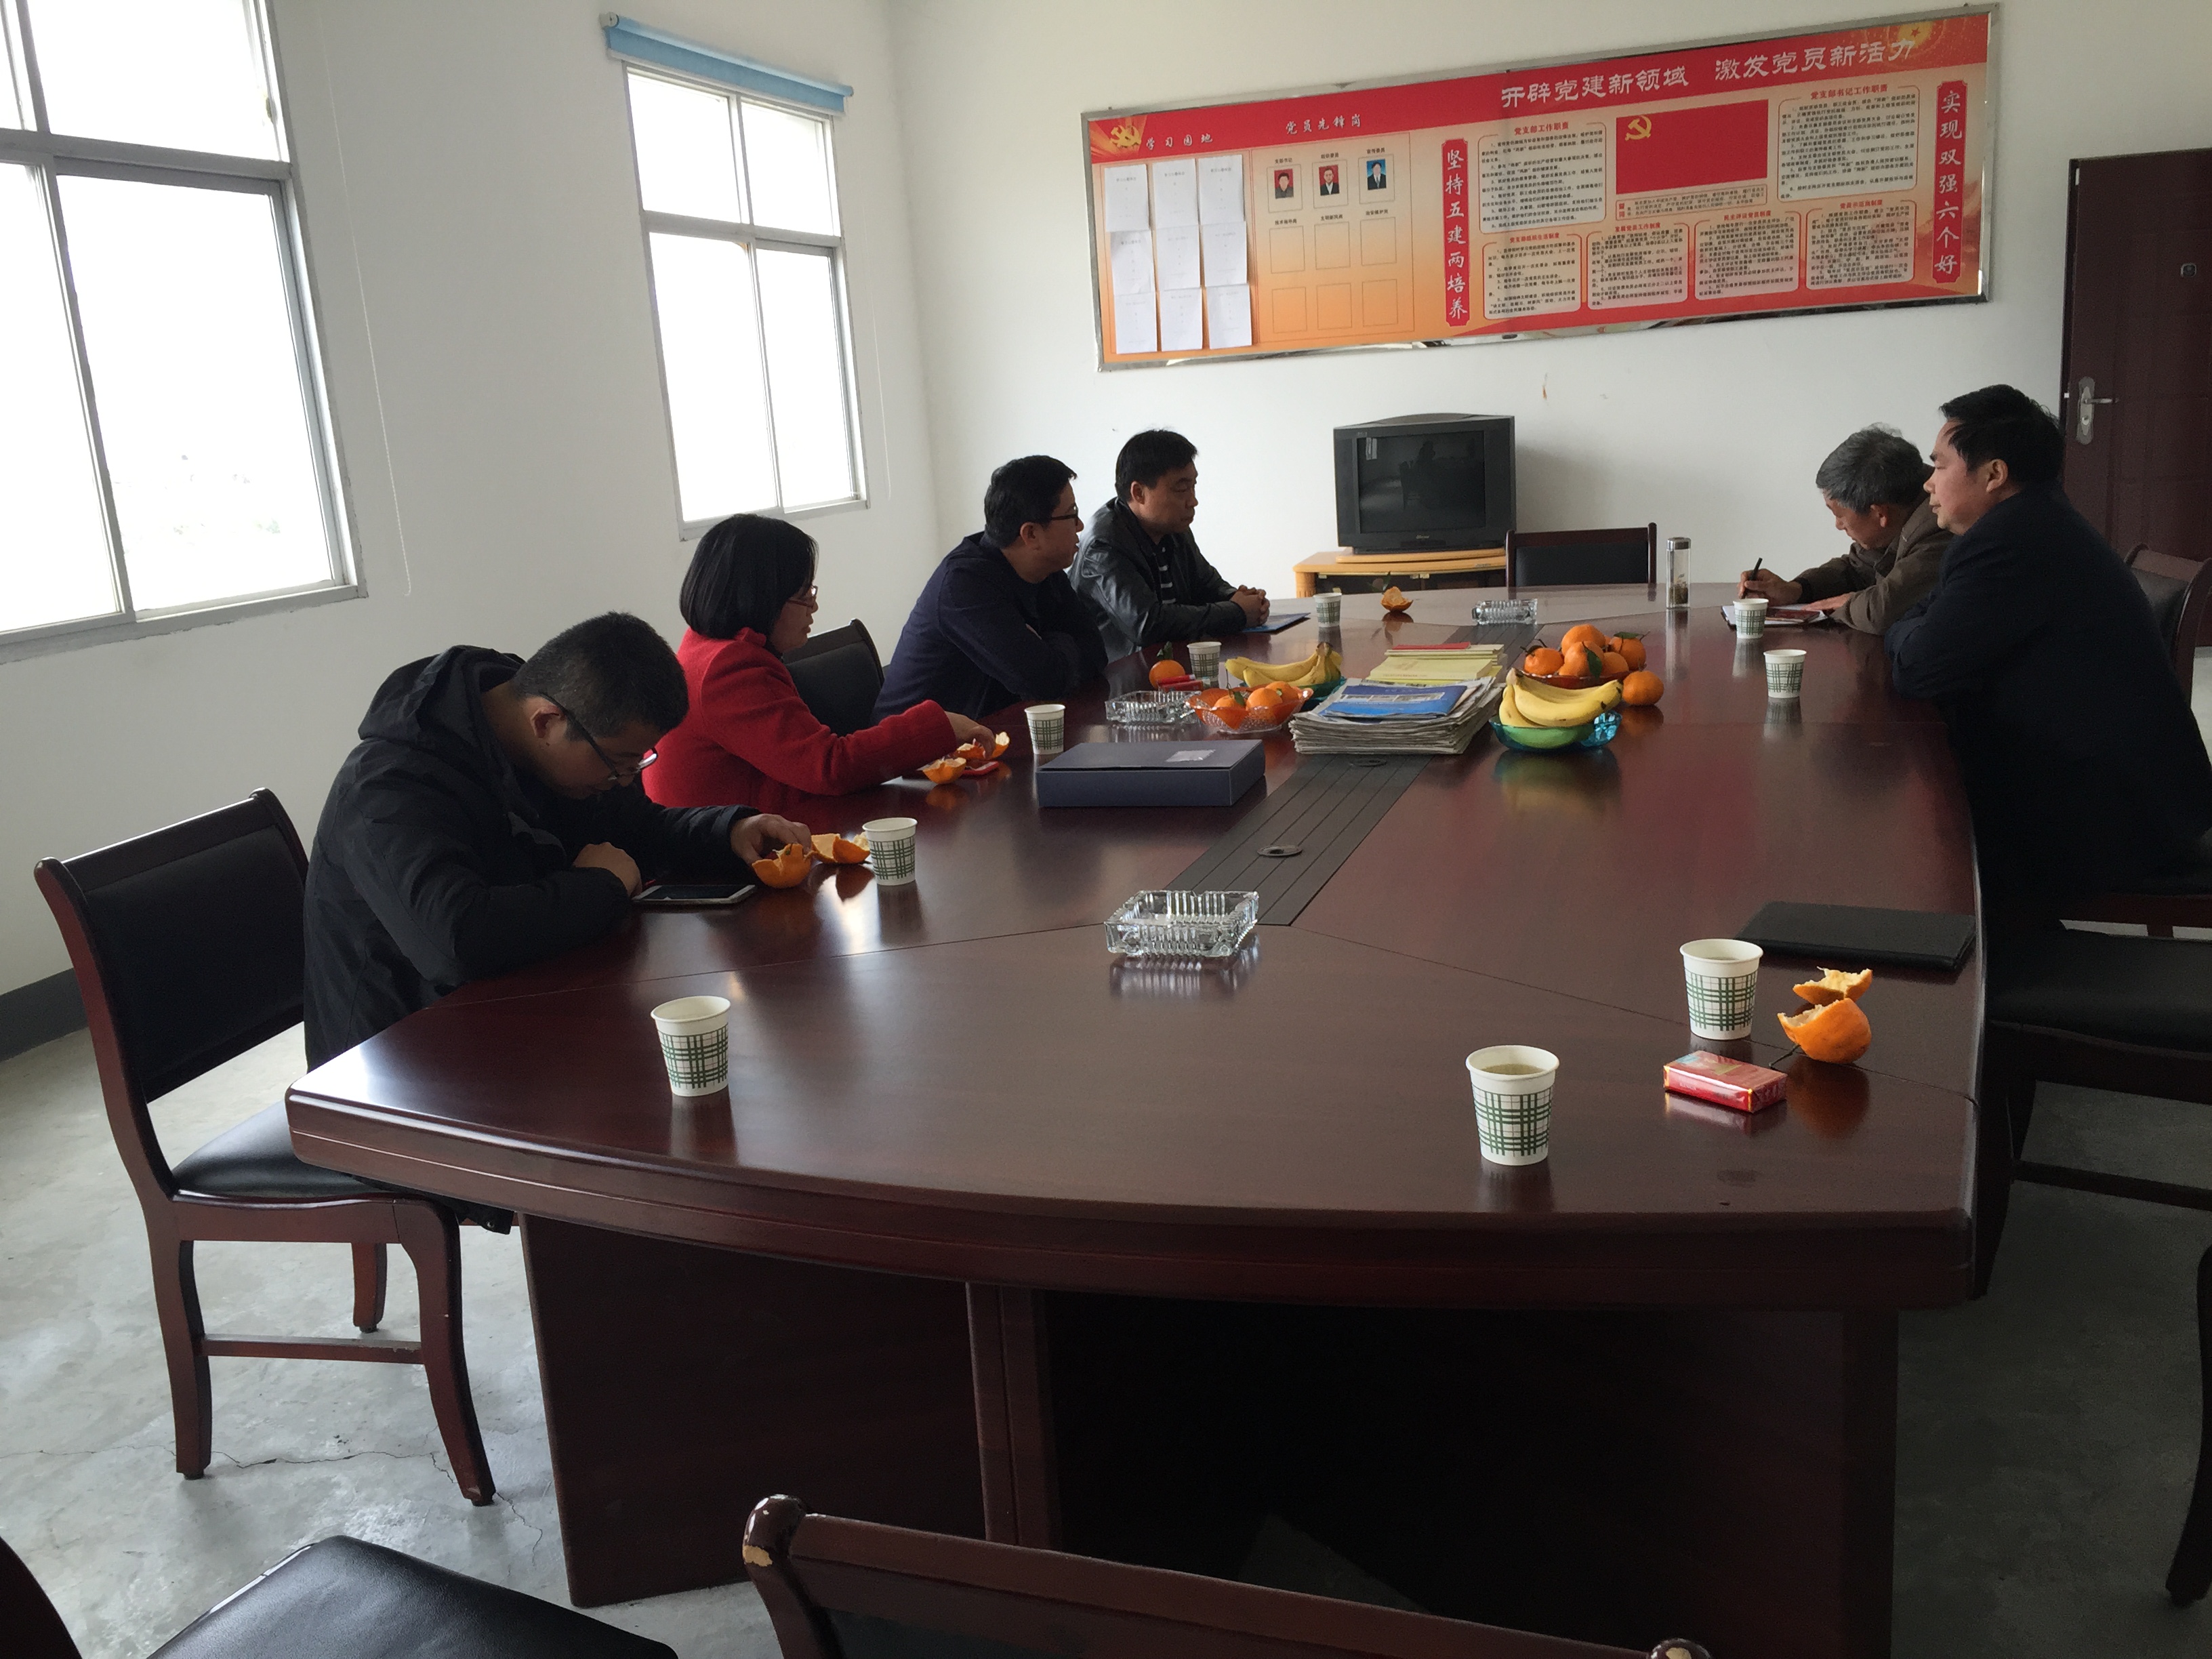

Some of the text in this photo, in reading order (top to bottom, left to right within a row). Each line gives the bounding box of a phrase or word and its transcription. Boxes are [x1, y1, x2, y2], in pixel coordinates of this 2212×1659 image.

[1715, 38, 1915, 81] 激发党员新活力
[1501, 66, 1689, 108] 开辟党建新领域
[1810, 84, 1889, 100] 党支部书记工作职责
[1286, 114, 1361, 135] 党员先锋岗
[1514, 121, 1570, 136] 党支部工作职责
[1934, 89, 1963, 274] 实现双强六个好
[1445, 148, 1468, 320] 坚持五建两培养
